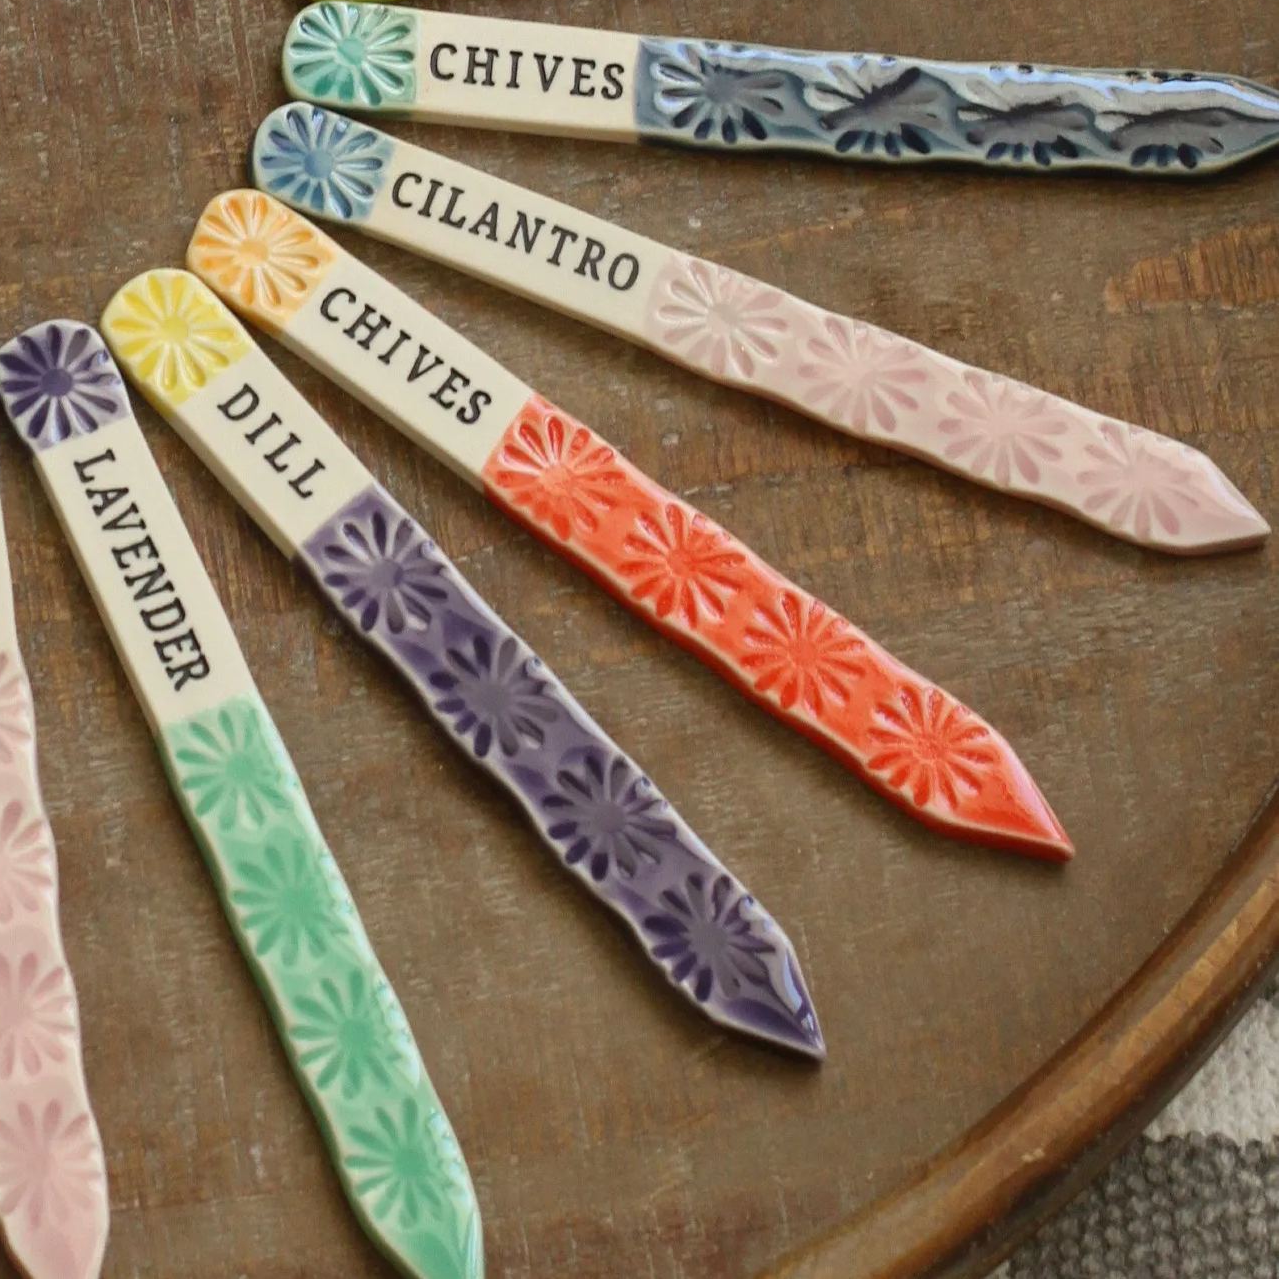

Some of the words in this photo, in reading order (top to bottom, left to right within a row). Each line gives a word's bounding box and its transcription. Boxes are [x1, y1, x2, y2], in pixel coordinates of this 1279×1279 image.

[429, 42, 625, 100] CHIVES
[392, 172, 640, 291] CILANTRO
[320, 287, 492, 425] CHIVES
[216, 383, 326, 499] DILL
[73, 448, 210, 692] LAVENDER
